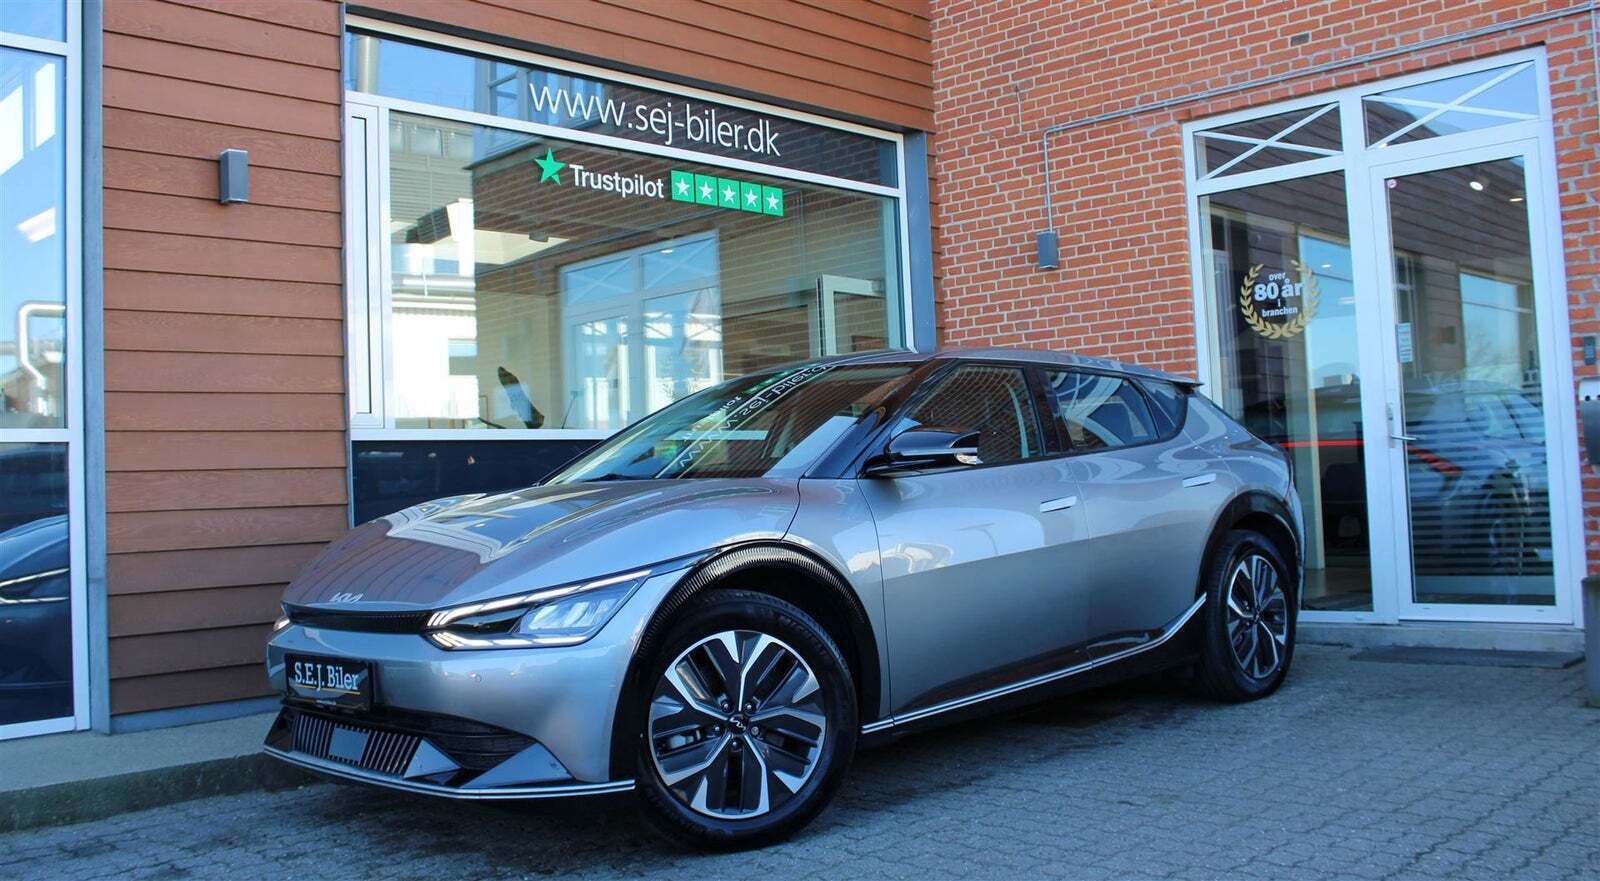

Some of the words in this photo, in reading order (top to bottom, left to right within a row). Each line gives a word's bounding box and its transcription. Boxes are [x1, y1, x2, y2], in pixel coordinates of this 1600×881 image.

[529, 83, 782, 157] www.sej-biler.dk
[569, 163, 665, 199] Trustpilot
[1269, 273, 1286, 281] over
[1254, 282, 1279, 301] 80
[1281, 279, 1304, 297] år
[1262, 307, 1298, 317] branchen
[294, 662, 325, 691] S.E.J.
[327, 665, 359, 690] Biler
